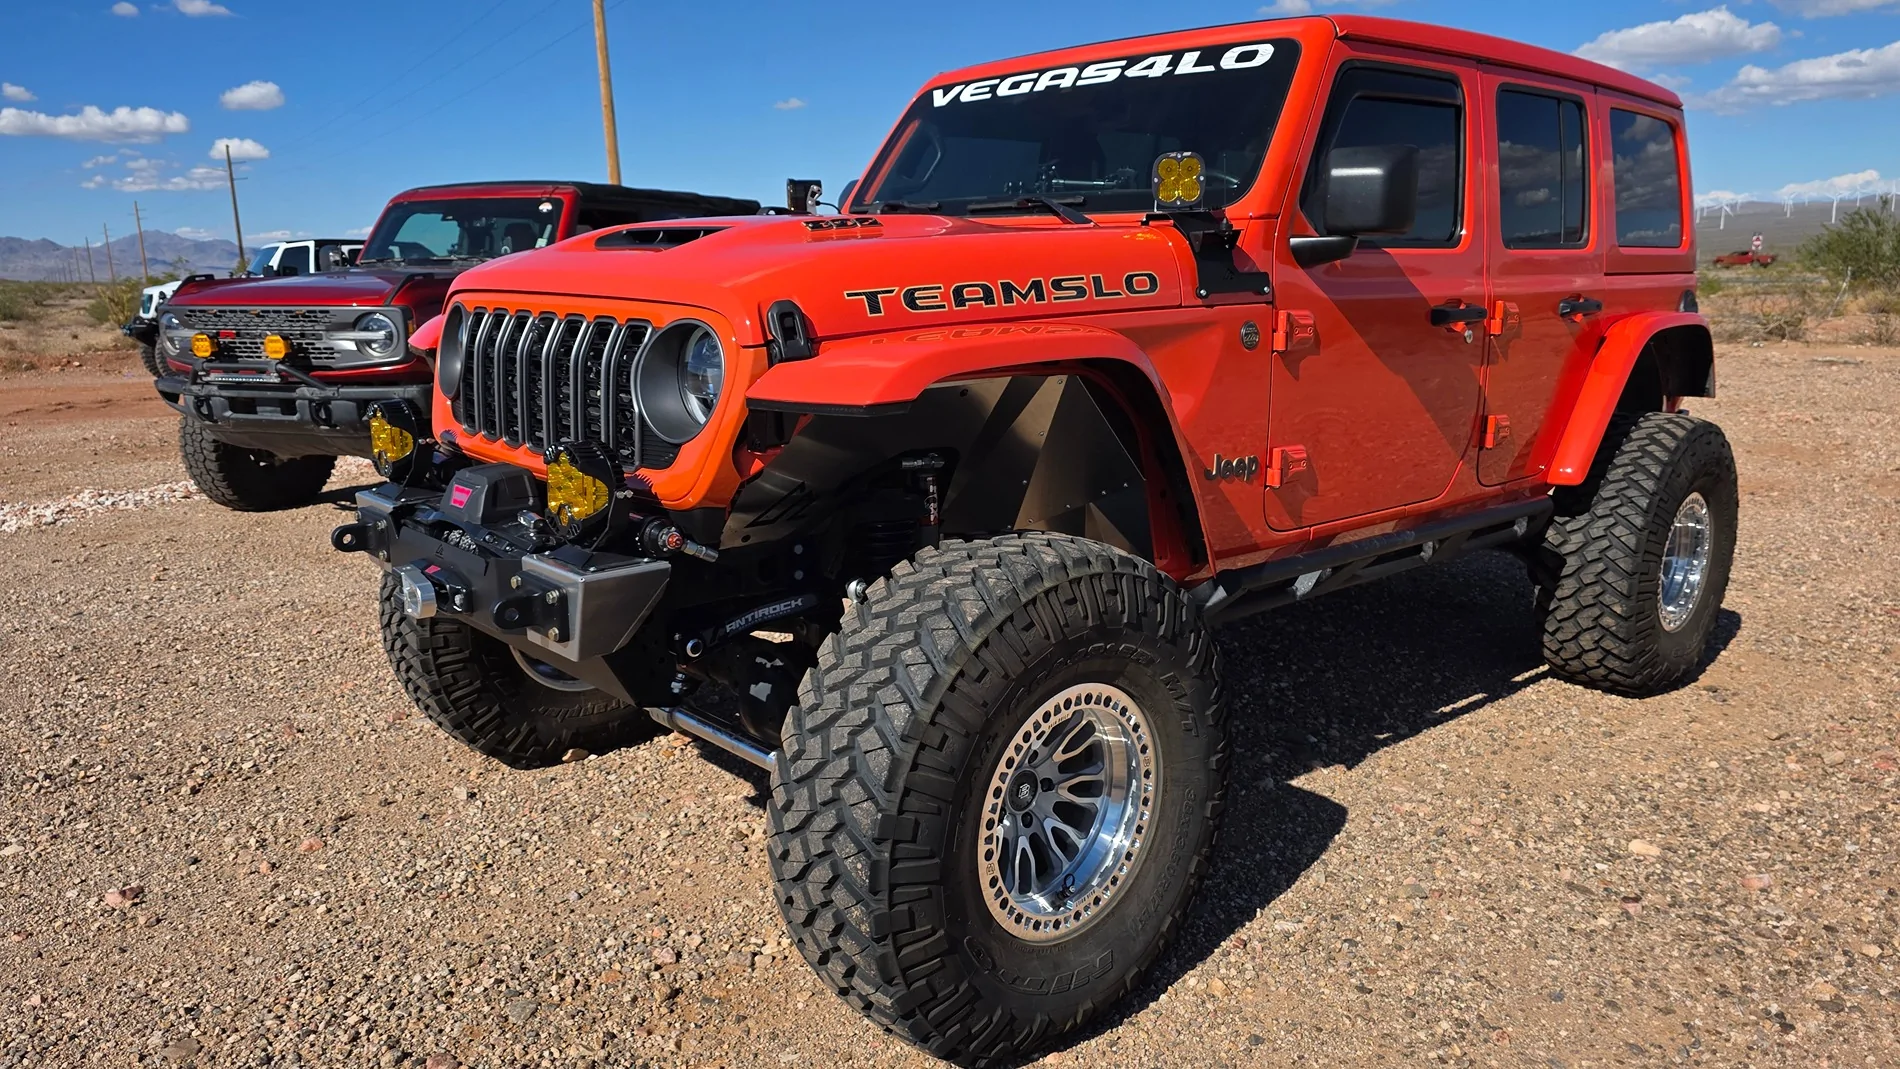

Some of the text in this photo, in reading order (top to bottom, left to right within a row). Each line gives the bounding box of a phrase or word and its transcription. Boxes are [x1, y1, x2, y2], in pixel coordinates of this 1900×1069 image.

[932, 43, 1275, 108] VEGAS4LO
[843, 270, 1160, 317] TEAMSLO
[1204, 454, 1259, 482] Jeep
[725, 597, 804, 633] ANTIROCK
